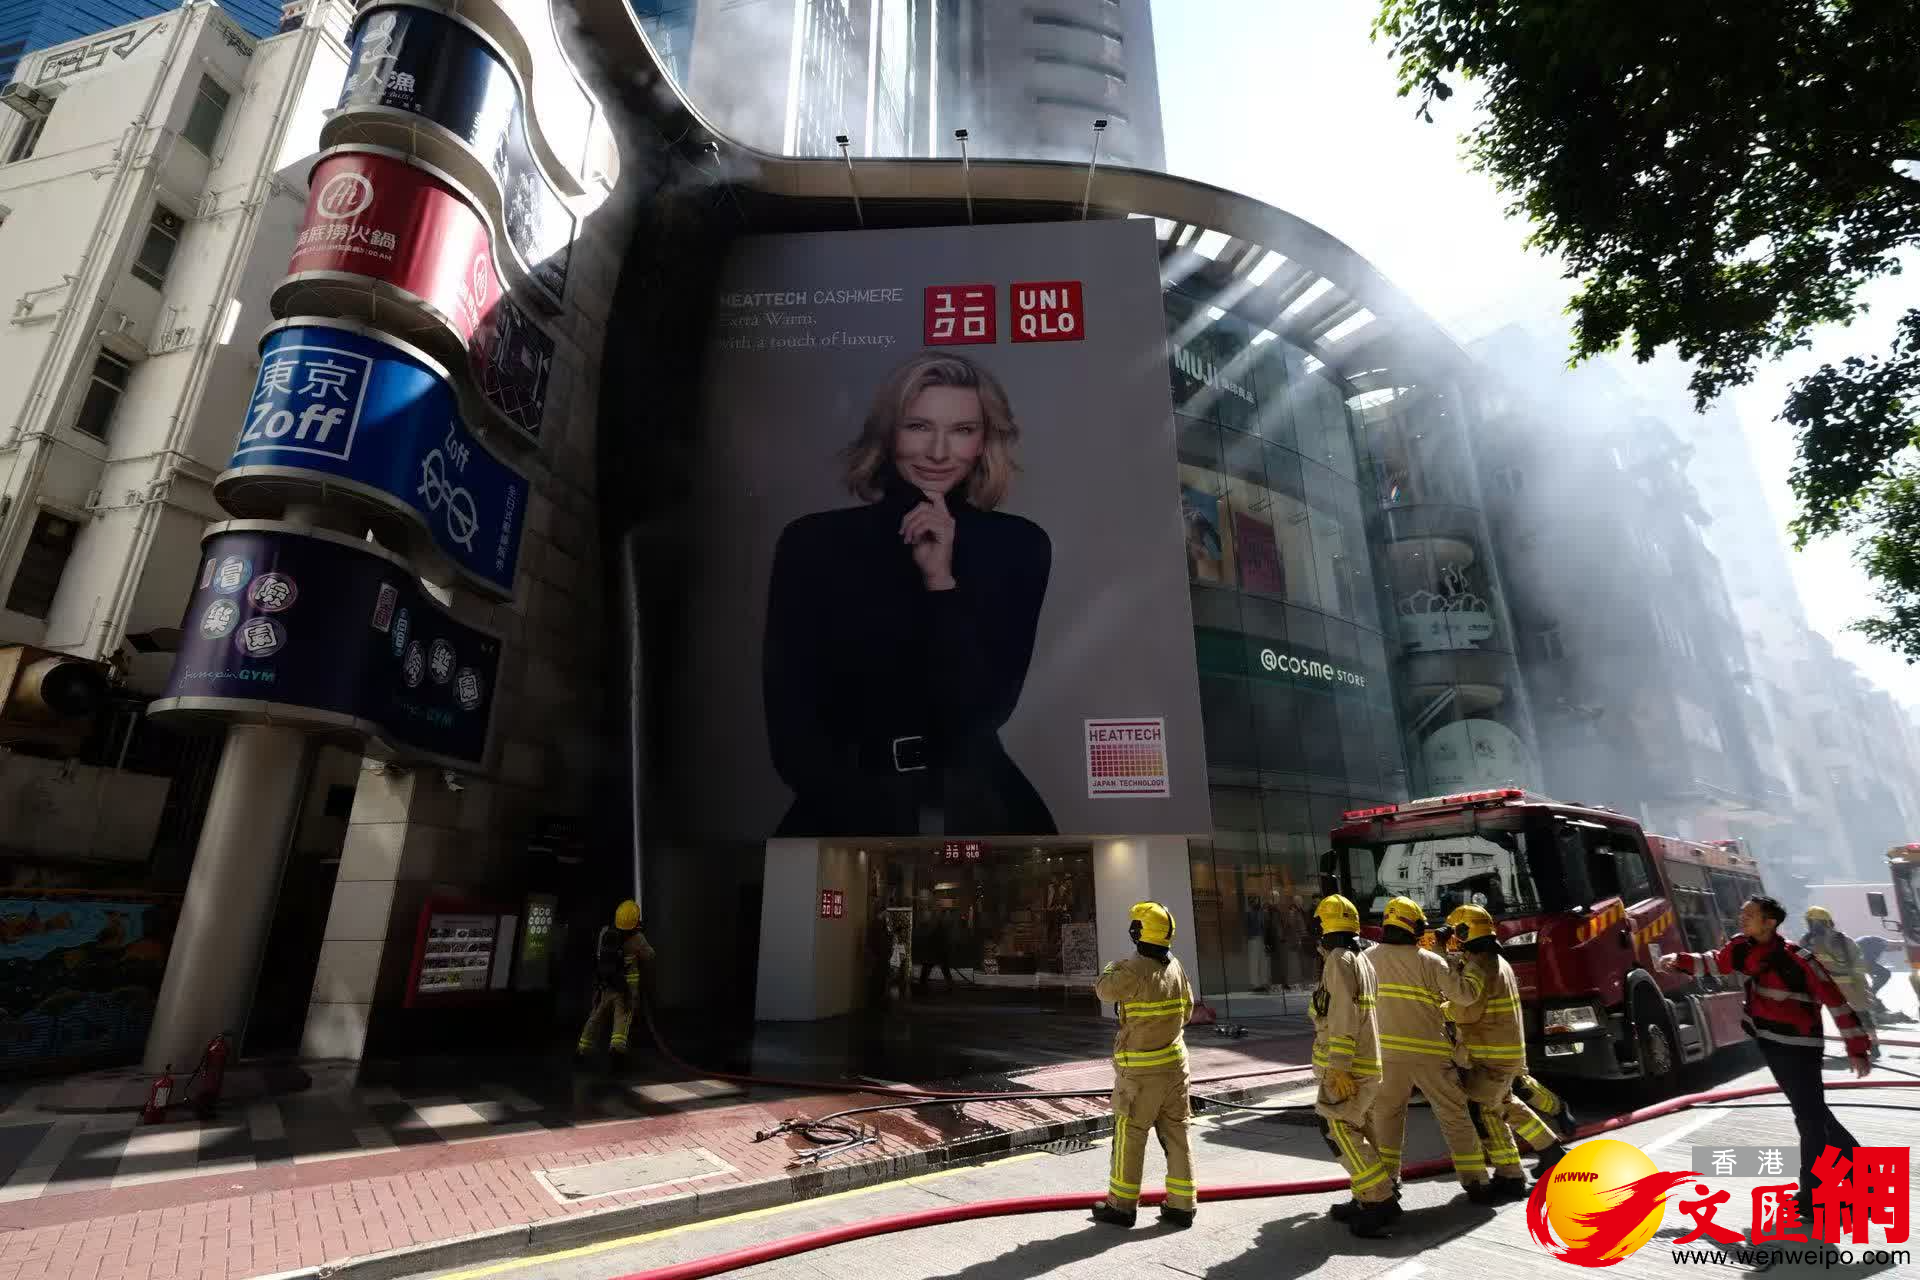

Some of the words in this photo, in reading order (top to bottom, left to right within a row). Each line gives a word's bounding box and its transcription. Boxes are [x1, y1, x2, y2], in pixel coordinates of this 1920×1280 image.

[813, 287, 905, 305] CASHMERE
[1019, 287, 1070, 310] UNI
[1020, 313, 1075, 338] QLO
[769, 333, 816, 349] touch
[821, 330, 840, 347] of
[841, 330, 897, 352] luxury.
[1174, 343, 1219, 391] MUJI
[255, 360, 357, 404] 東京
[241, 403, 346, 444] Zoff
[1260, 648, 1334, 681] @cosme
[1336, 669, 1365, 688] STORE
[1089, 728, 1161, 742] HEATTECH
[1092, 779, 1117, 788] JAPAN
[1119, 779, 1165, 788] TECHNOLOGY
